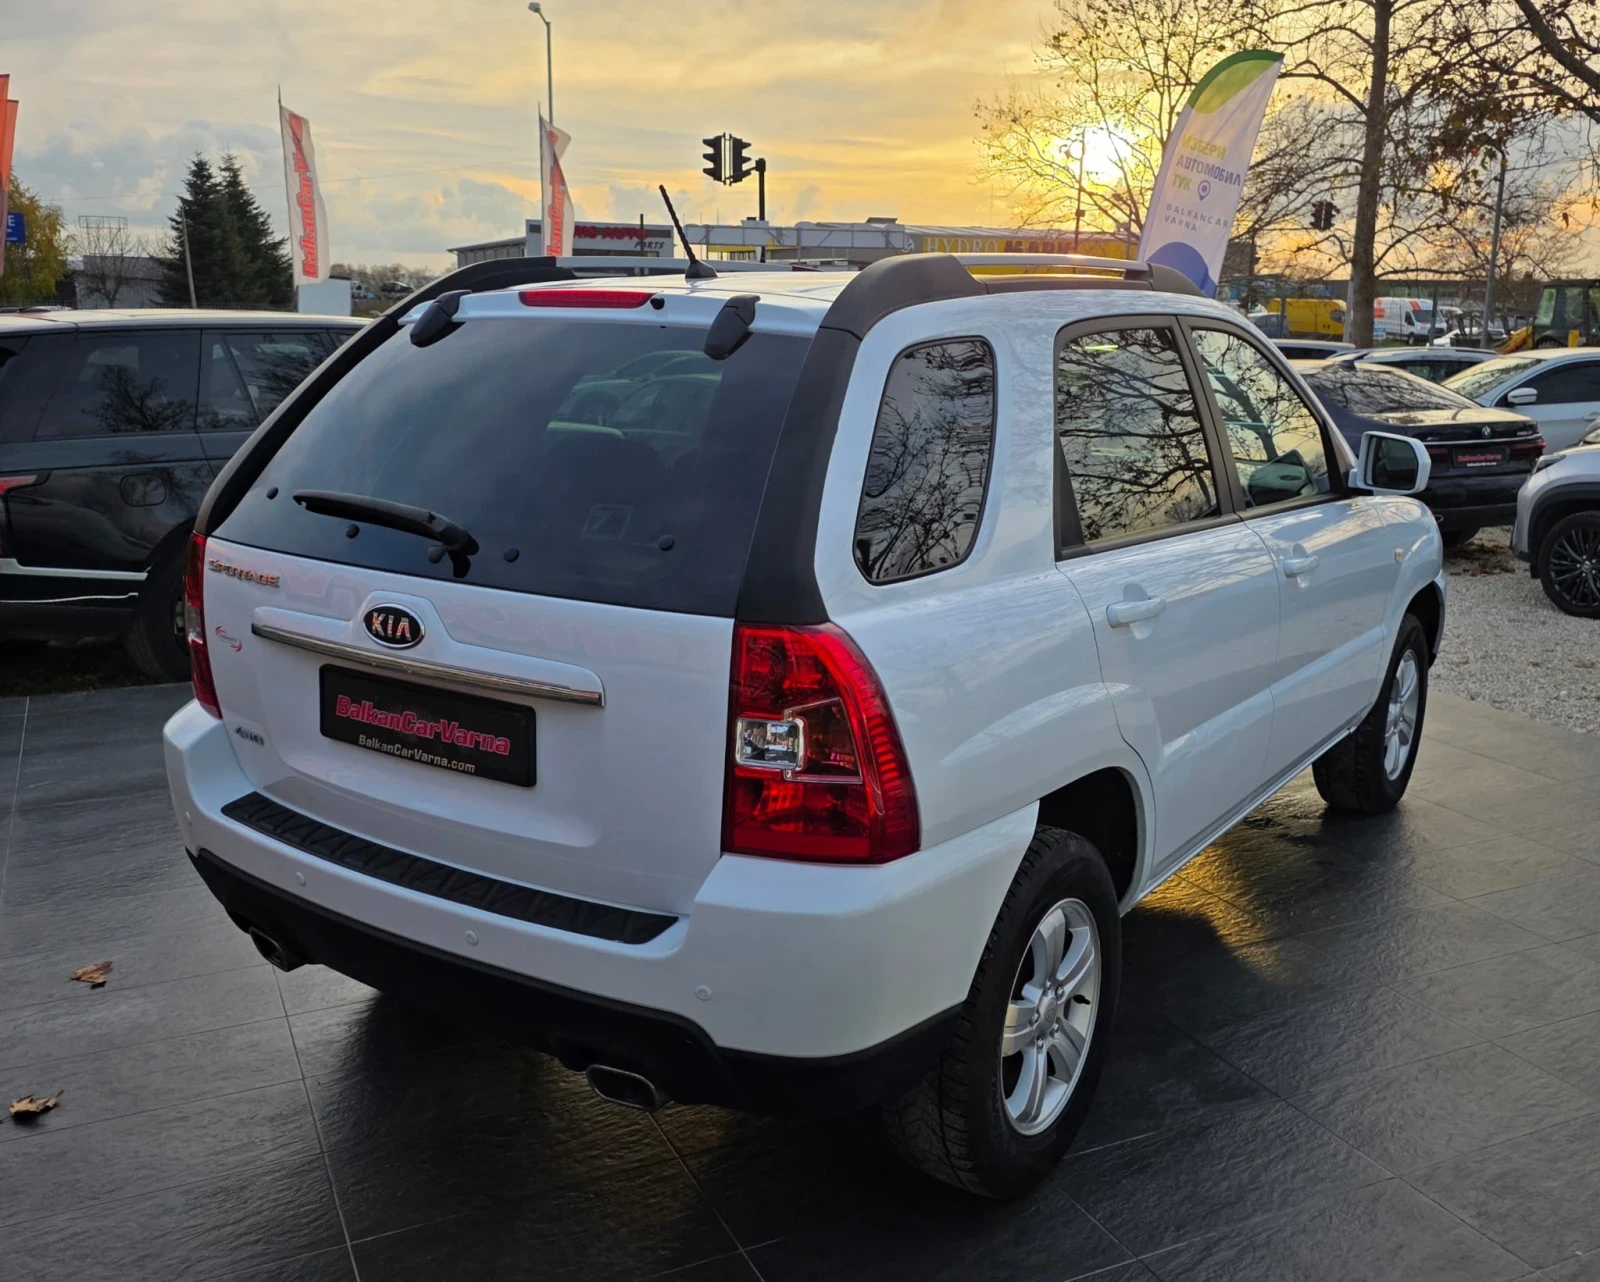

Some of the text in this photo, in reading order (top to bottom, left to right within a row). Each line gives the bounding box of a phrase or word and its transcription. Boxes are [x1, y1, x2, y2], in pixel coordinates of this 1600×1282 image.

[1180, 134, 1227, 160] ИЗБЕРИ
[1171, 173, 1191, 193] ТУК
[1176, 155, 1241, 187] АВТОМОБИЛ
[1164, 214, 1197, 232] VARNA
[633, 240, 665, 250] PARTS
[926, 237, 998, 254] HYDRO
[208, 558, 281, 588] SPORTAGE
[371, 611, 412, 642] KIA
[335, 694, 511, 757] BalkanCarVarna
[357, 734, 477, 775] BalkanCarVarna.com
